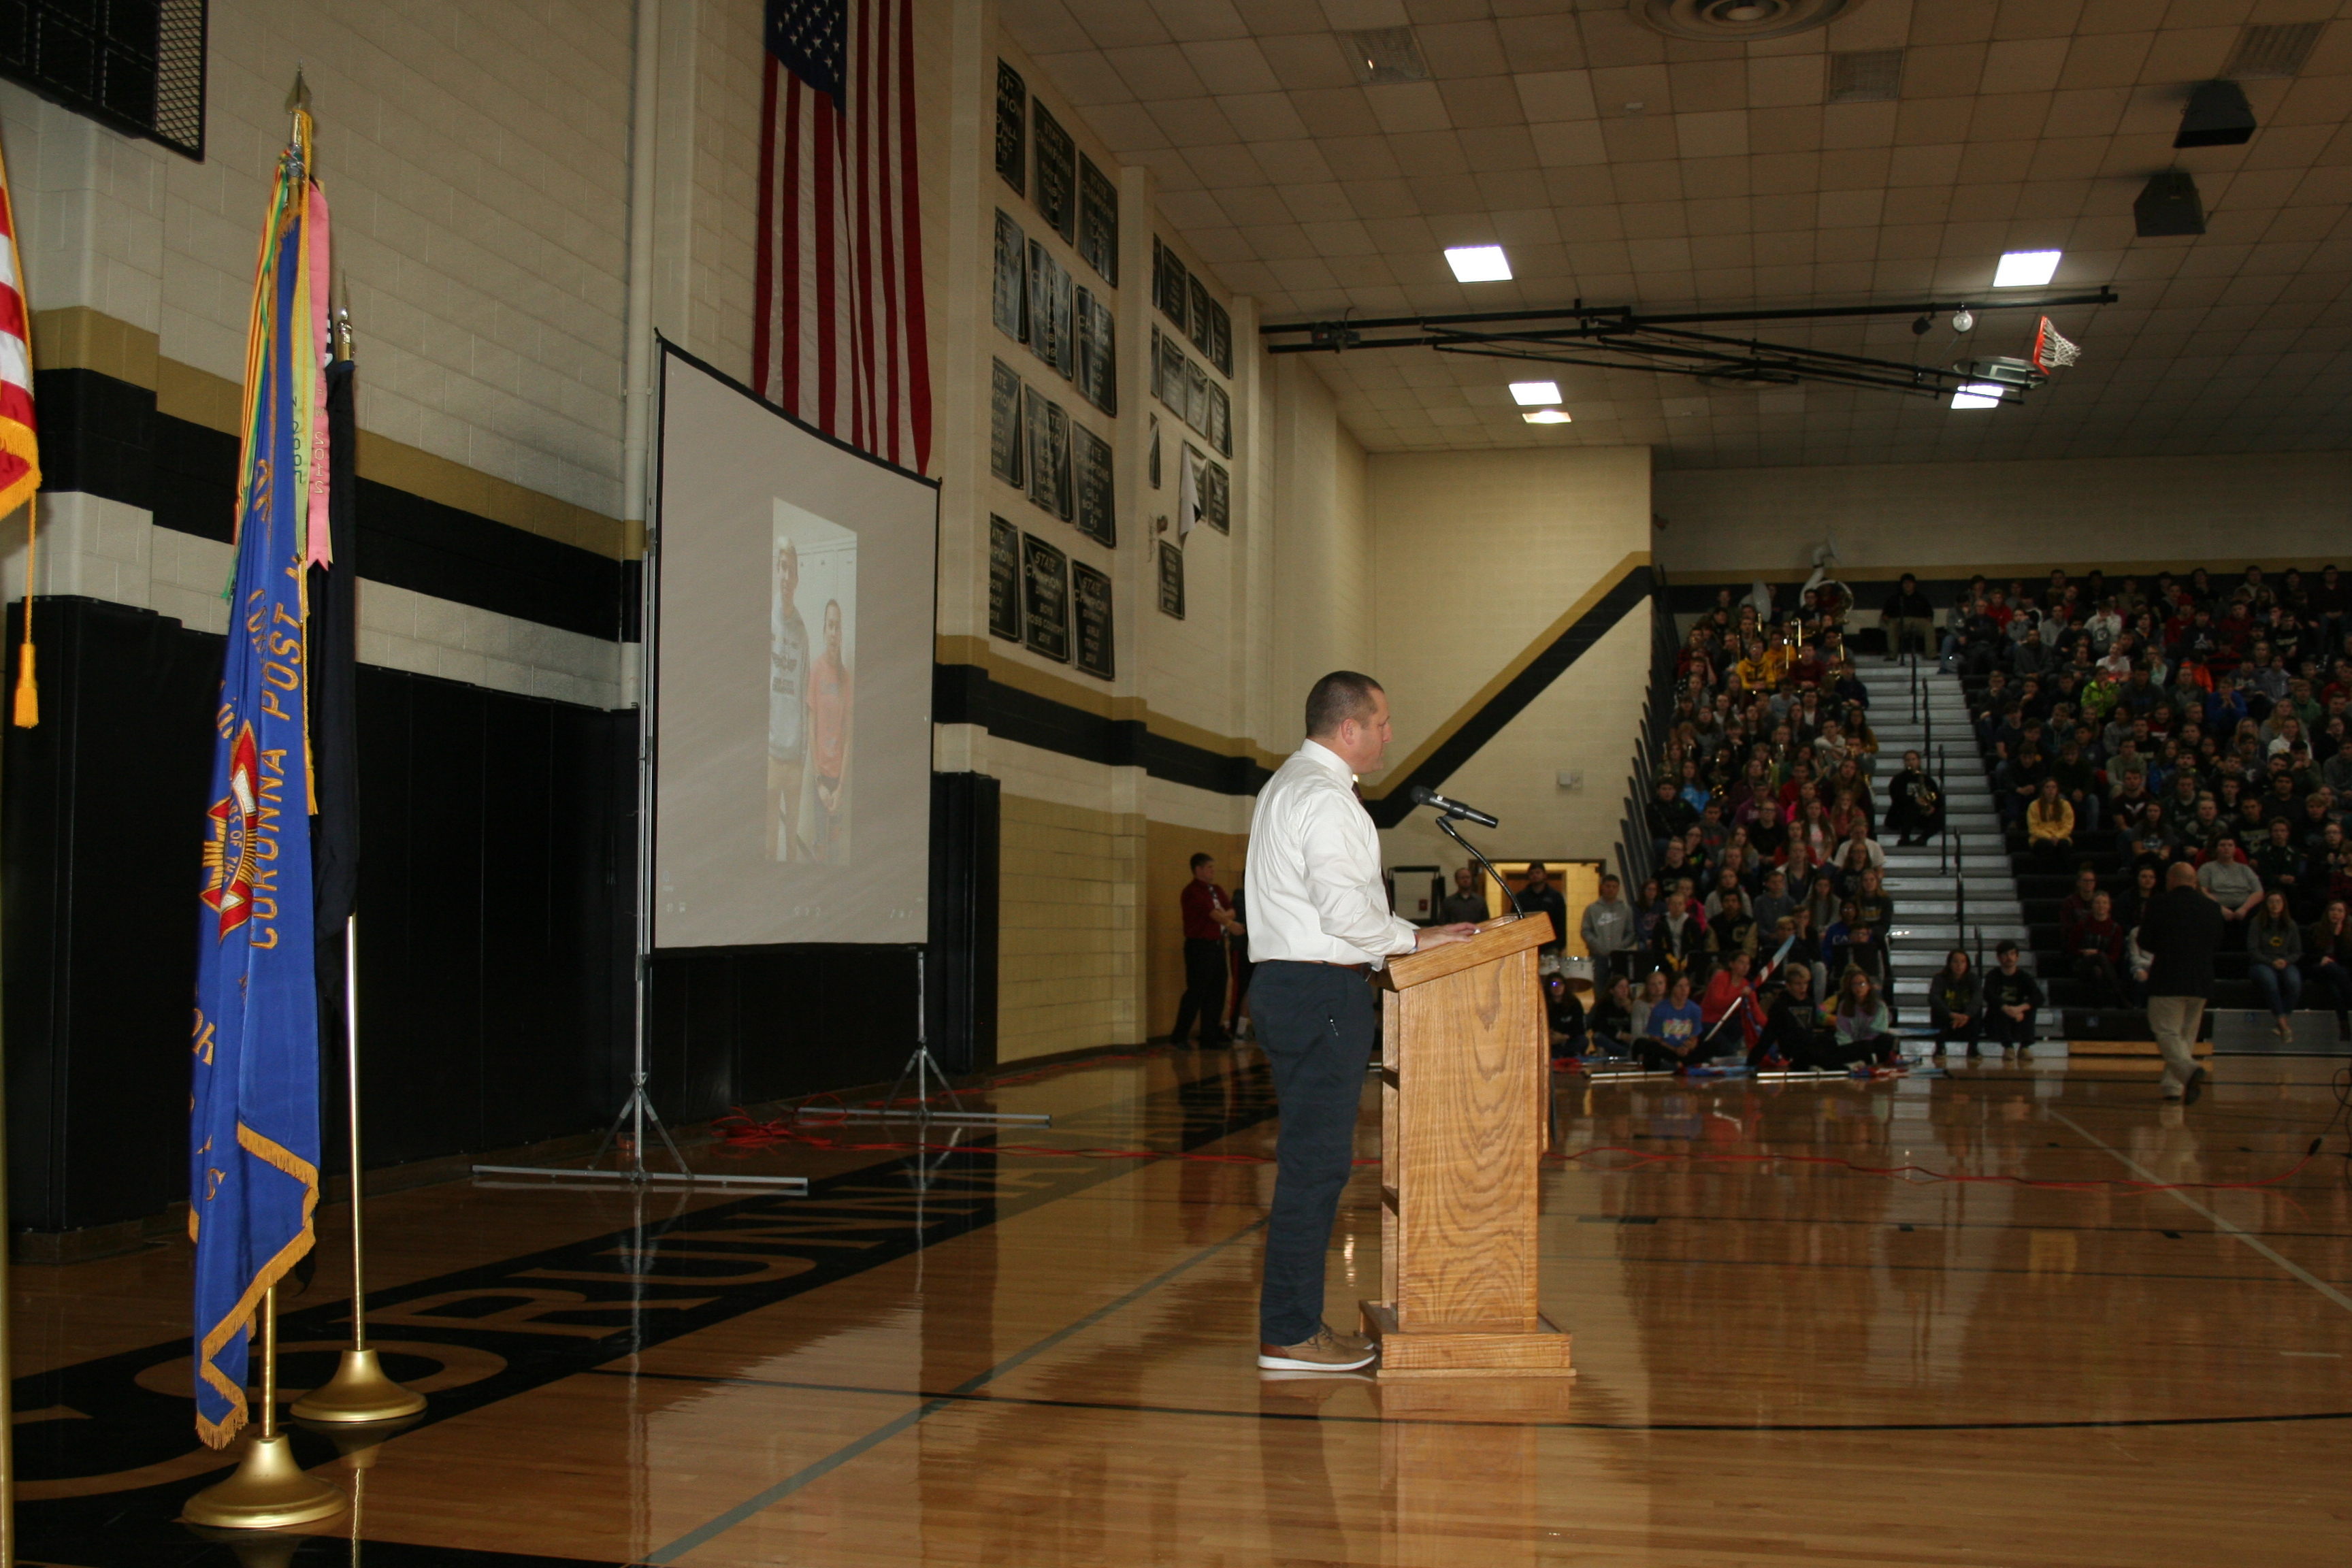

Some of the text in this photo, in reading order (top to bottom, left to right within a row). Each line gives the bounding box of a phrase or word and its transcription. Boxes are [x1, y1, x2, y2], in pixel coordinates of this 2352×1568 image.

[1034, 549, 1056, 573] STATE
[261, 602, 302, 721] POST
[229, 830, 244, 848] OF
[249, 749, 287, 950] CORUNNA
